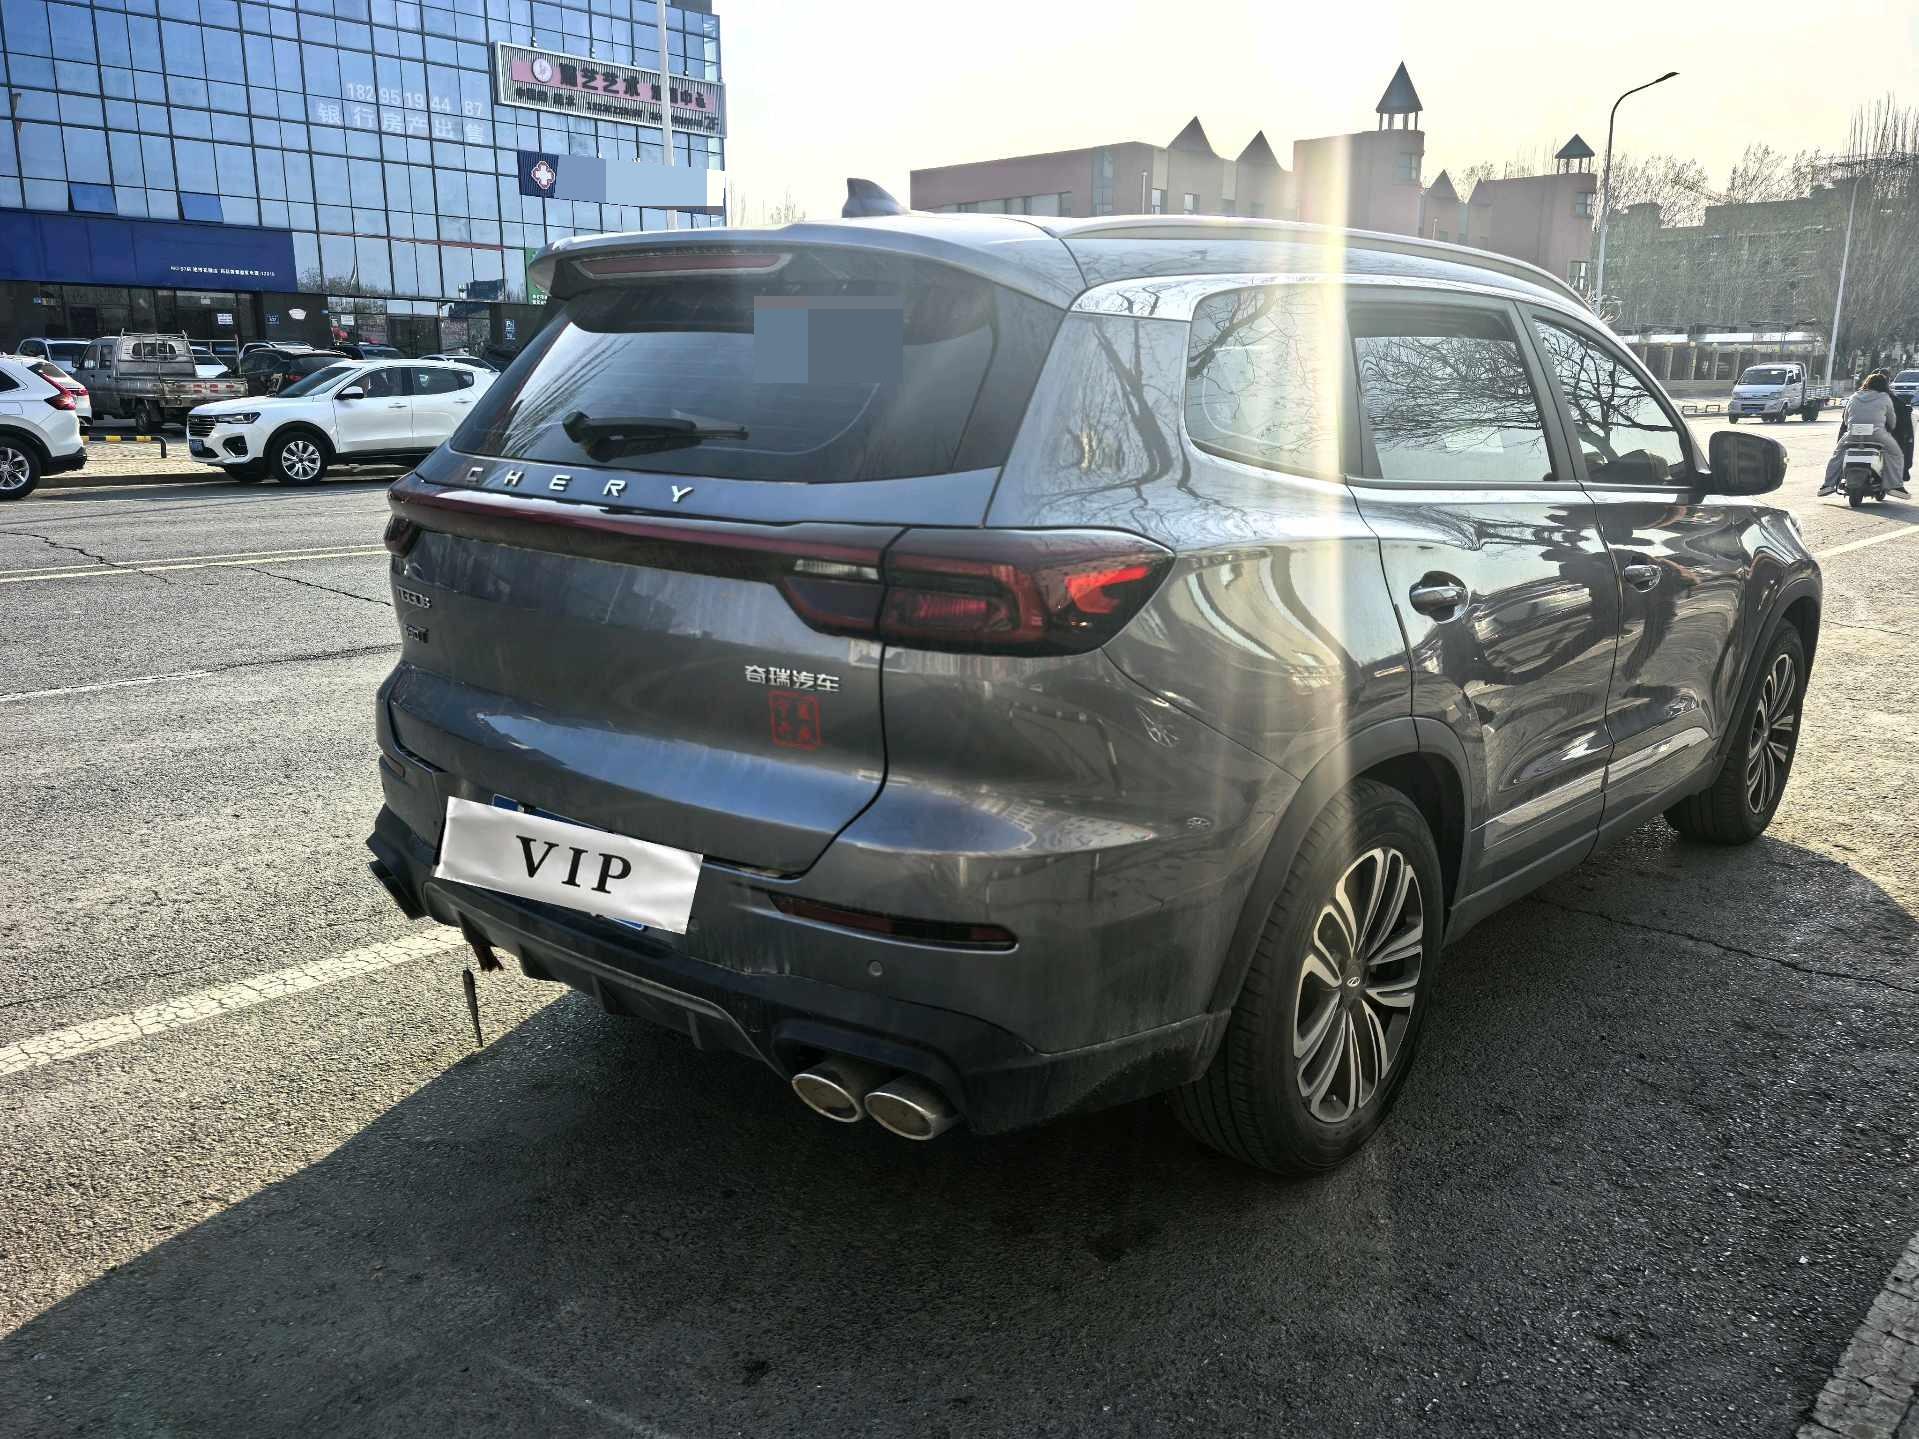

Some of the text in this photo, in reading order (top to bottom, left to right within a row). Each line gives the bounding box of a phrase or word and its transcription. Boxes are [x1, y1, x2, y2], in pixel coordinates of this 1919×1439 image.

[318, 102, 485, 143] 银行房产出售
[465, 466, 693, 504] CHERY
[744, 664, 840, 692] 奇瑞汽车
[516, 834, 632, 894] VIP
